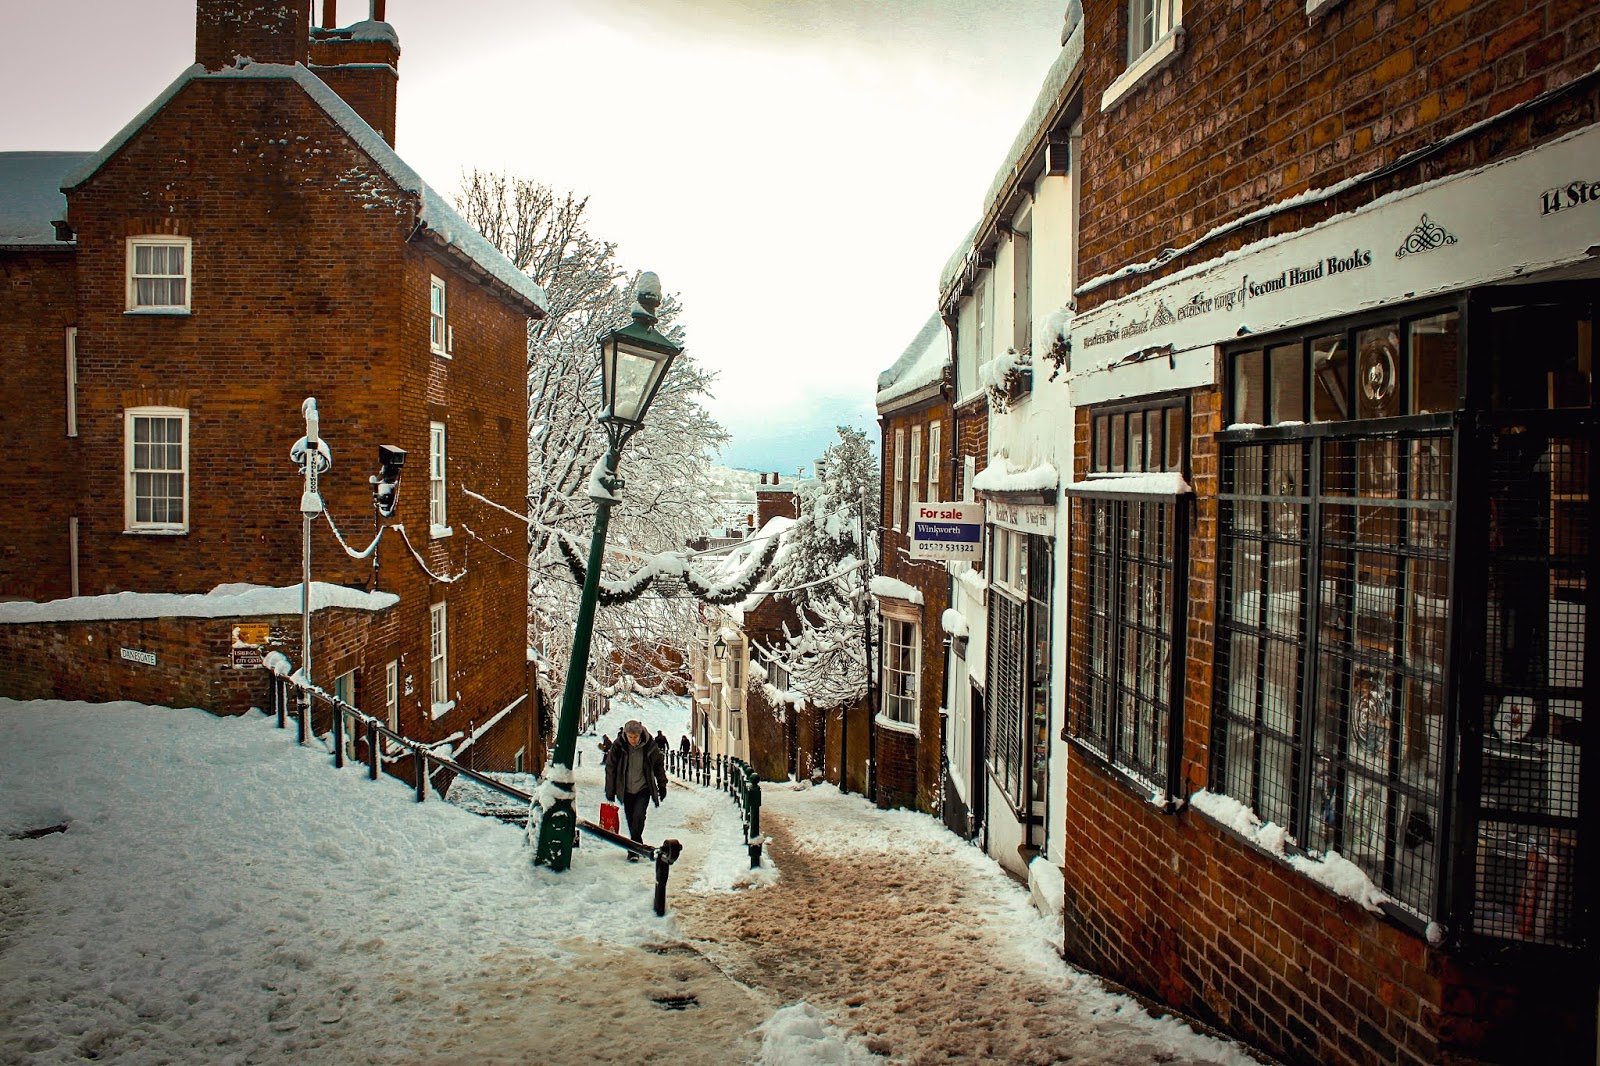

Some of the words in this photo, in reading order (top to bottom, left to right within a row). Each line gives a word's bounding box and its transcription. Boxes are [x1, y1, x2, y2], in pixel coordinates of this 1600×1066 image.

[1541, 189, 1561, 215] 14
[1567, 183, 1600, 207] Ste
[1214, 291, 1236, 311] range
[1238, 274, 1248, 308] of
[1249, 273, 1286, 298] Second
[1290, 260, 1323, 286] Hand
[1327, 249, 1371, 275] Books
[920, 508, 938, 518] For
[940, 508, 963, 519] sale
[917, 524, 961, 536] Winkworth
[945, 544, 975, 552] 531321
[122, 649, 155, 664] DANESGATE
